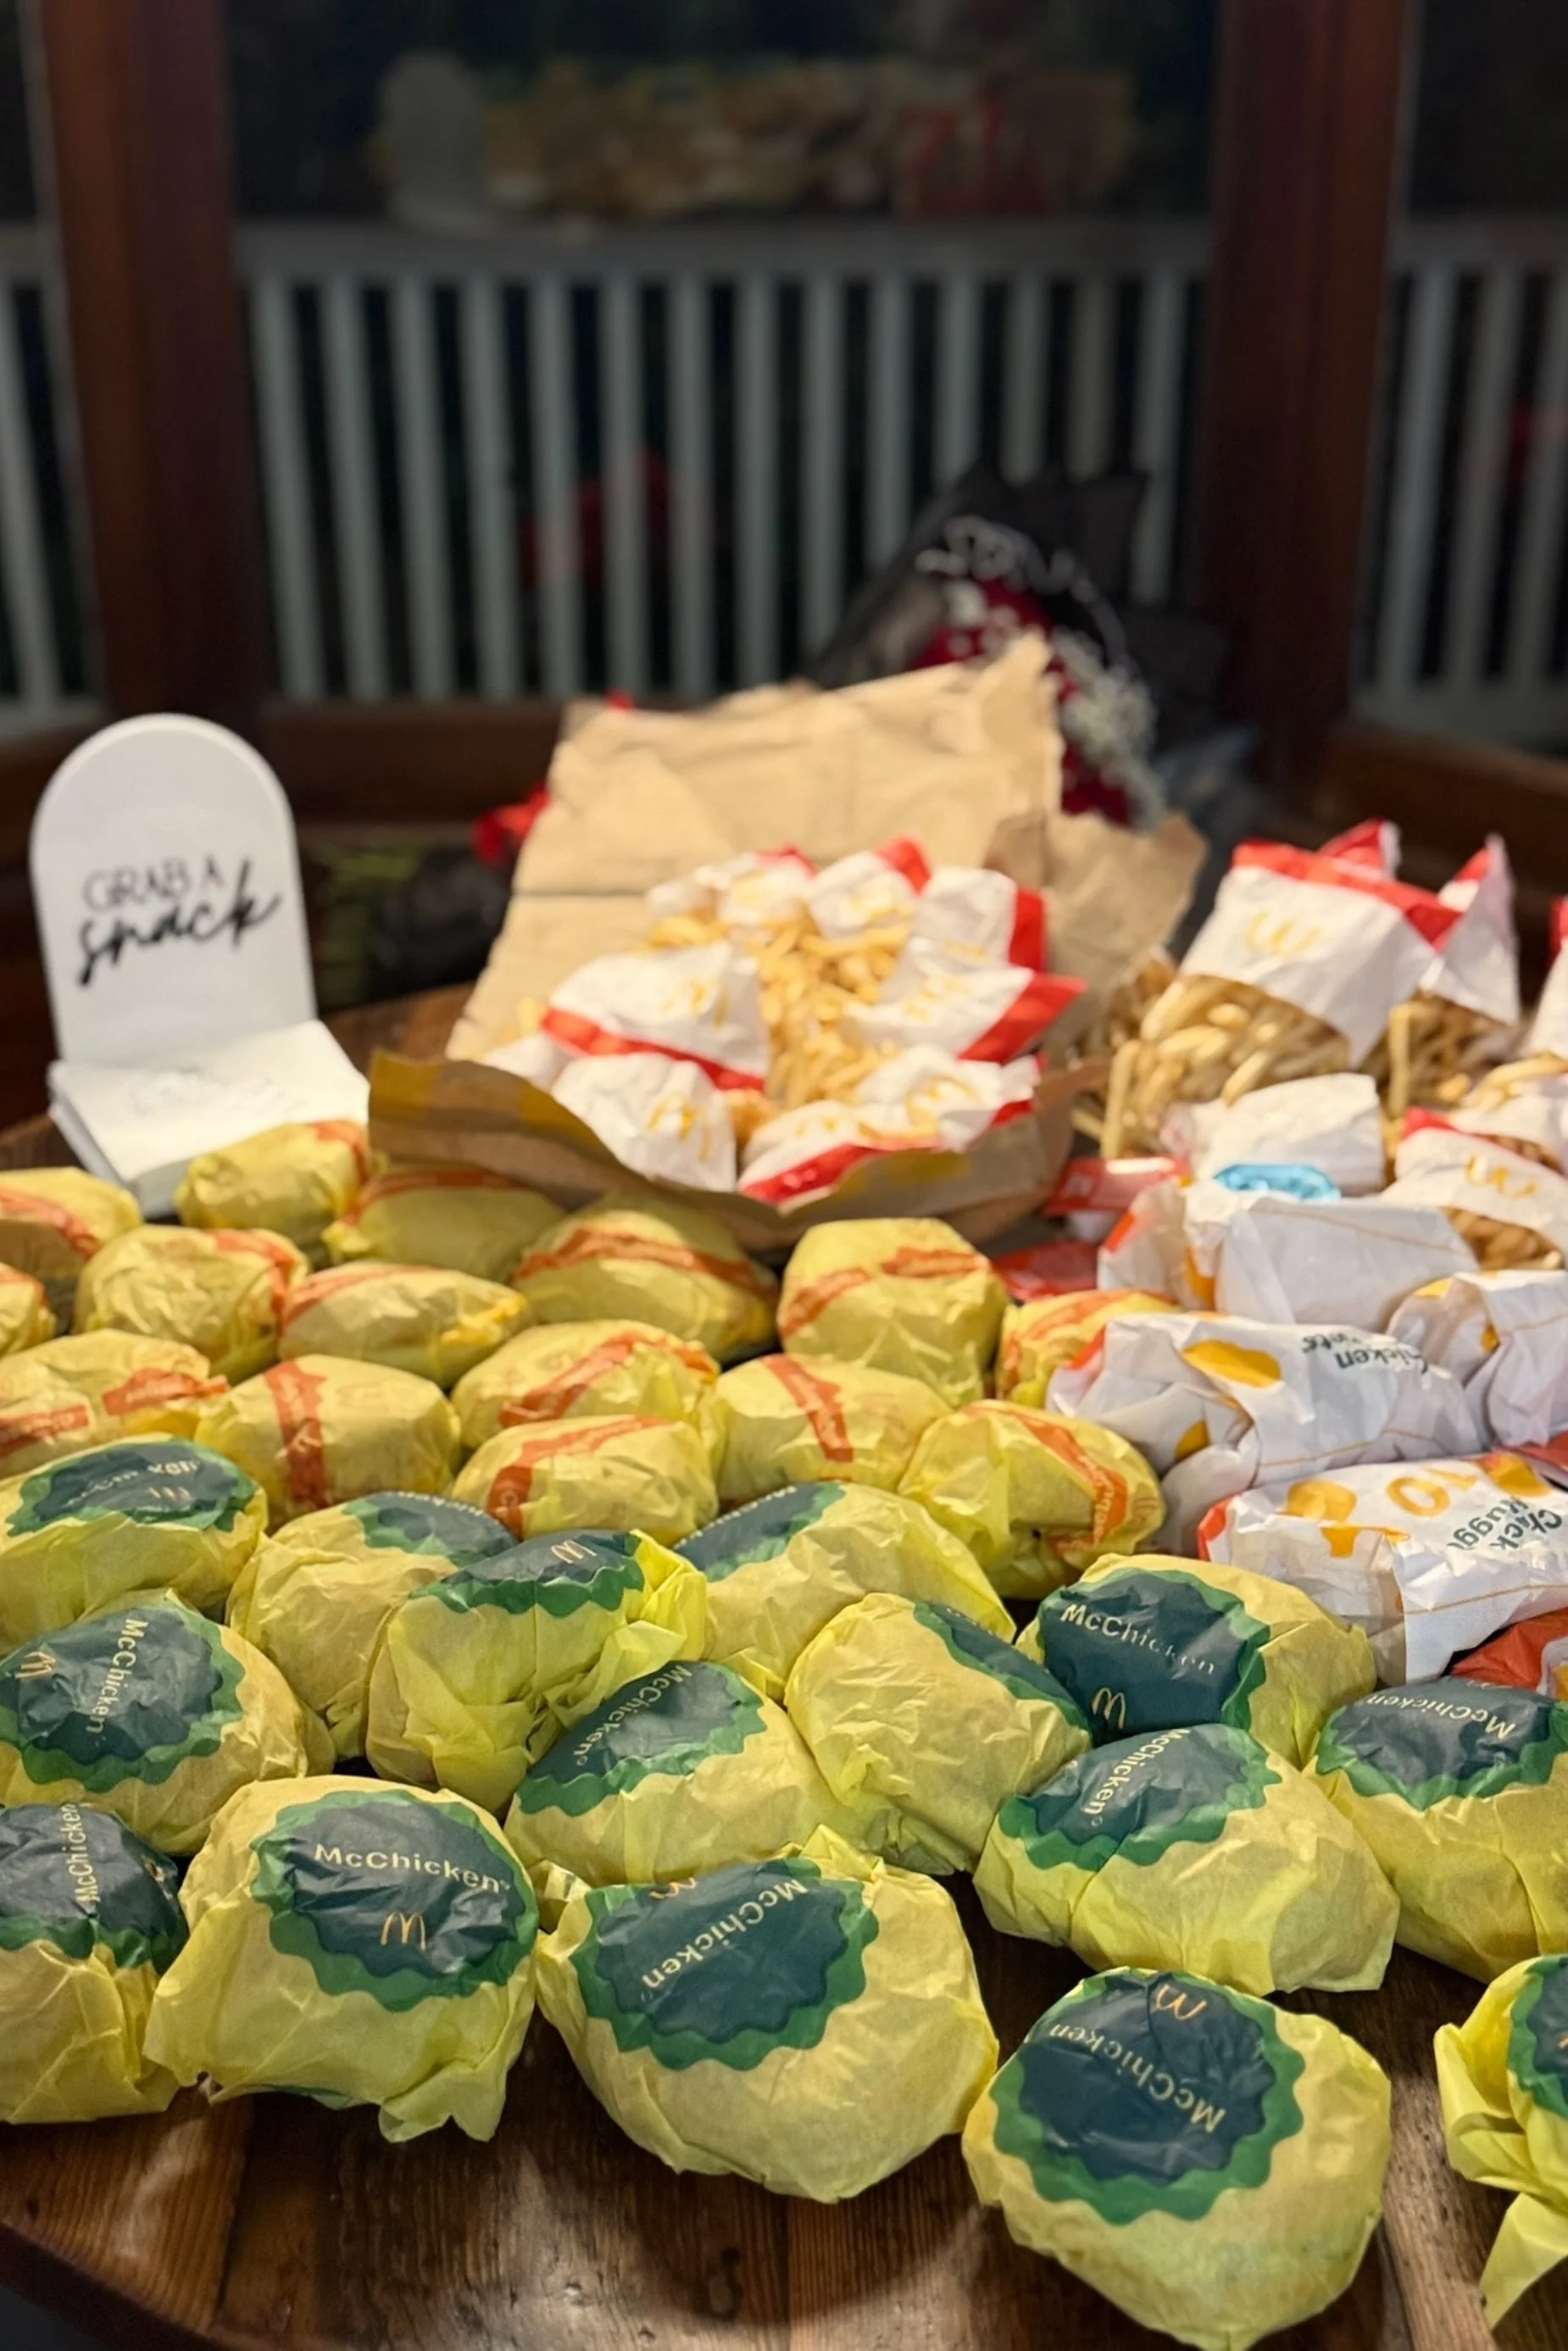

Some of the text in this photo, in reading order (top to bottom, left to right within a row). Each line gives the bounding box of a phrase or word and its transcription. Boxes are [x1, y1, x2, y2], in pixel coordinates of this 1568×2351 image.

[78, 859, 282, 986] snack
[83, 854, 225, 913] GRAB A
[86, 1618, 149, 1733] McChicken
[572, 1665, 692, 1756] McChicken
[1366, 1695, 1516, 1739] McChicken
[1082, 1729, 1192, 1815] McChicken
[59, 1803, 101, 1903] McChicken
[314, 1843, 500, 1894] McChicken
[642, 1879, 809, 1988] McChicken
[1048, 2024, 1226, 2133] McChicken
